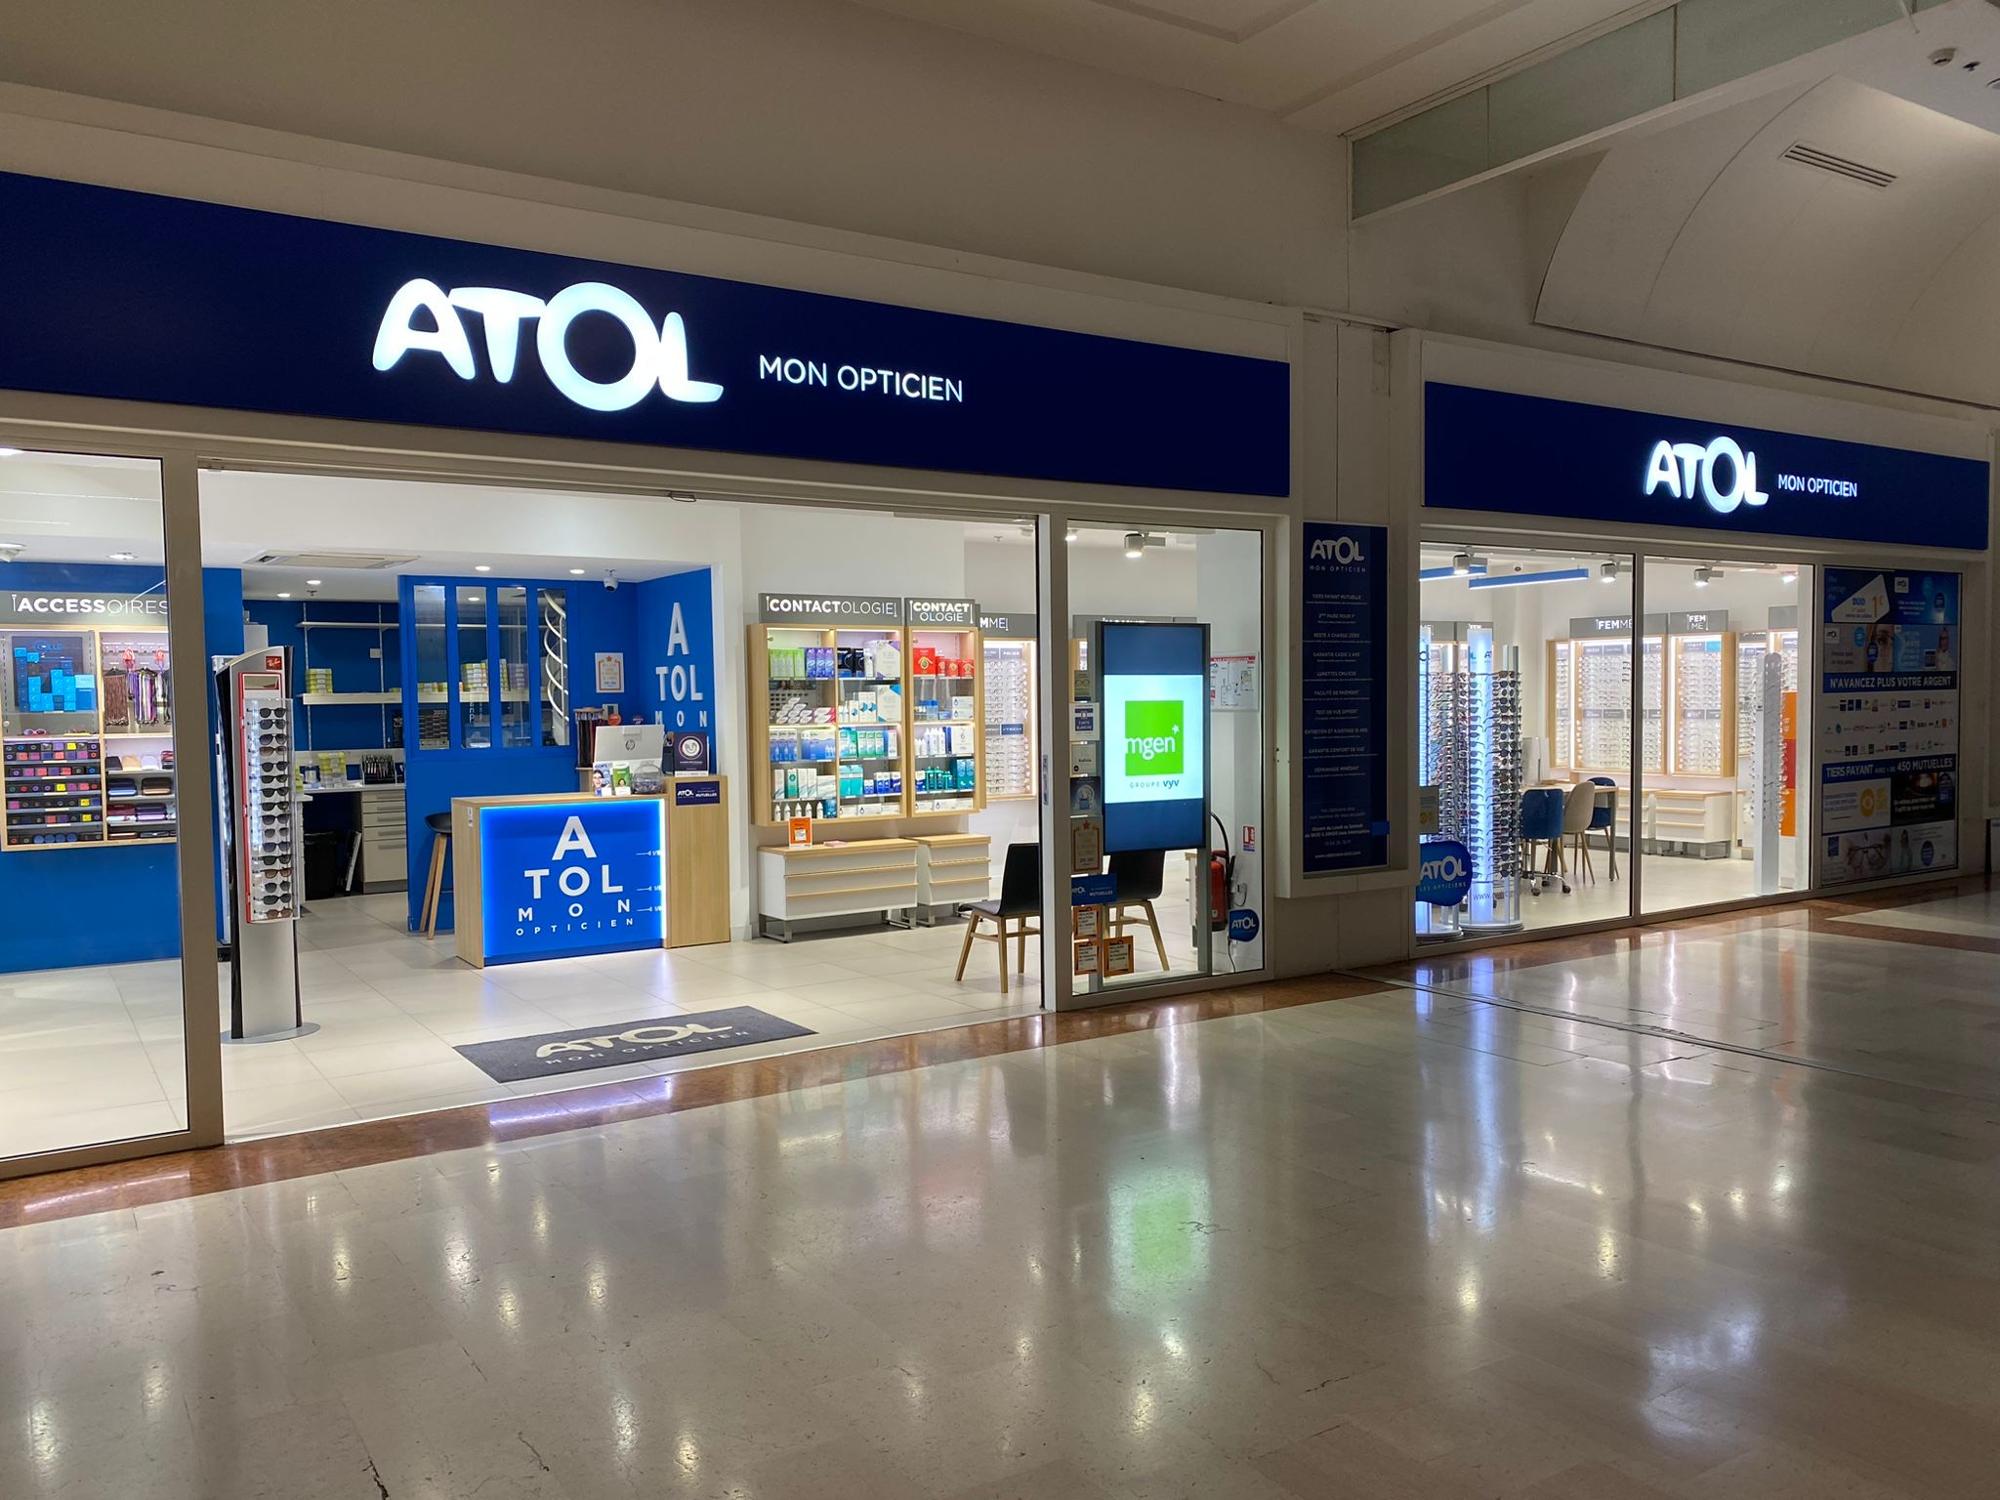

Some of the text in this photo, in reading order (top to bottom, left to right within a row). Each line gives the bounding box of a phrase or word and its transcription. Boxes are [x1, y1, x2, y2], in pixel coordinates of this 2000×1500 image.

[373, 278, 964, 412] ATOL MON OPTICIEN
[1644, 436, 1858, 513] ATOL MON OPTICIEN
[1310, 536, 1365, 565] ATOL
[1309, 564, 1326, 572] MON
[17, 597, 168, 615] ACCESSOIRES
[768, 598, 894, 616] CONTACTOLOGIE
[912, 600, 970, 613] CONTACT
[919, 611, 964, 623] OLOGIE
[1598, 618, 1632, 630] FEMME
[1688, 614, 1706, 623] FEM
[667, 602, 690, 656] A
[655, 664, 703, 702] TOL
[1830, 675, 1951, 688] N'AVANCEZ PLUS VOTRE ARGENT
[1125, 730, 1175, 760] mgen
[1846, 764, 1874, 776] PAYANT
[1912, 757, 1953, 770] MUTUELLES
[1163, 778, 1180, 790] vyv
[552, 815, 597, 861] A
[1420, 856, 1467, 882] ATOL
[524, 864, 623, 899] TOL
[516, 918, 633, 937] OPTICIEN
[1231, 917, 1257, 930] ATOL
[535, 1023, 733, 1058] ATOL
[545, 1030, 751, 1066] MON OPTICIEN
